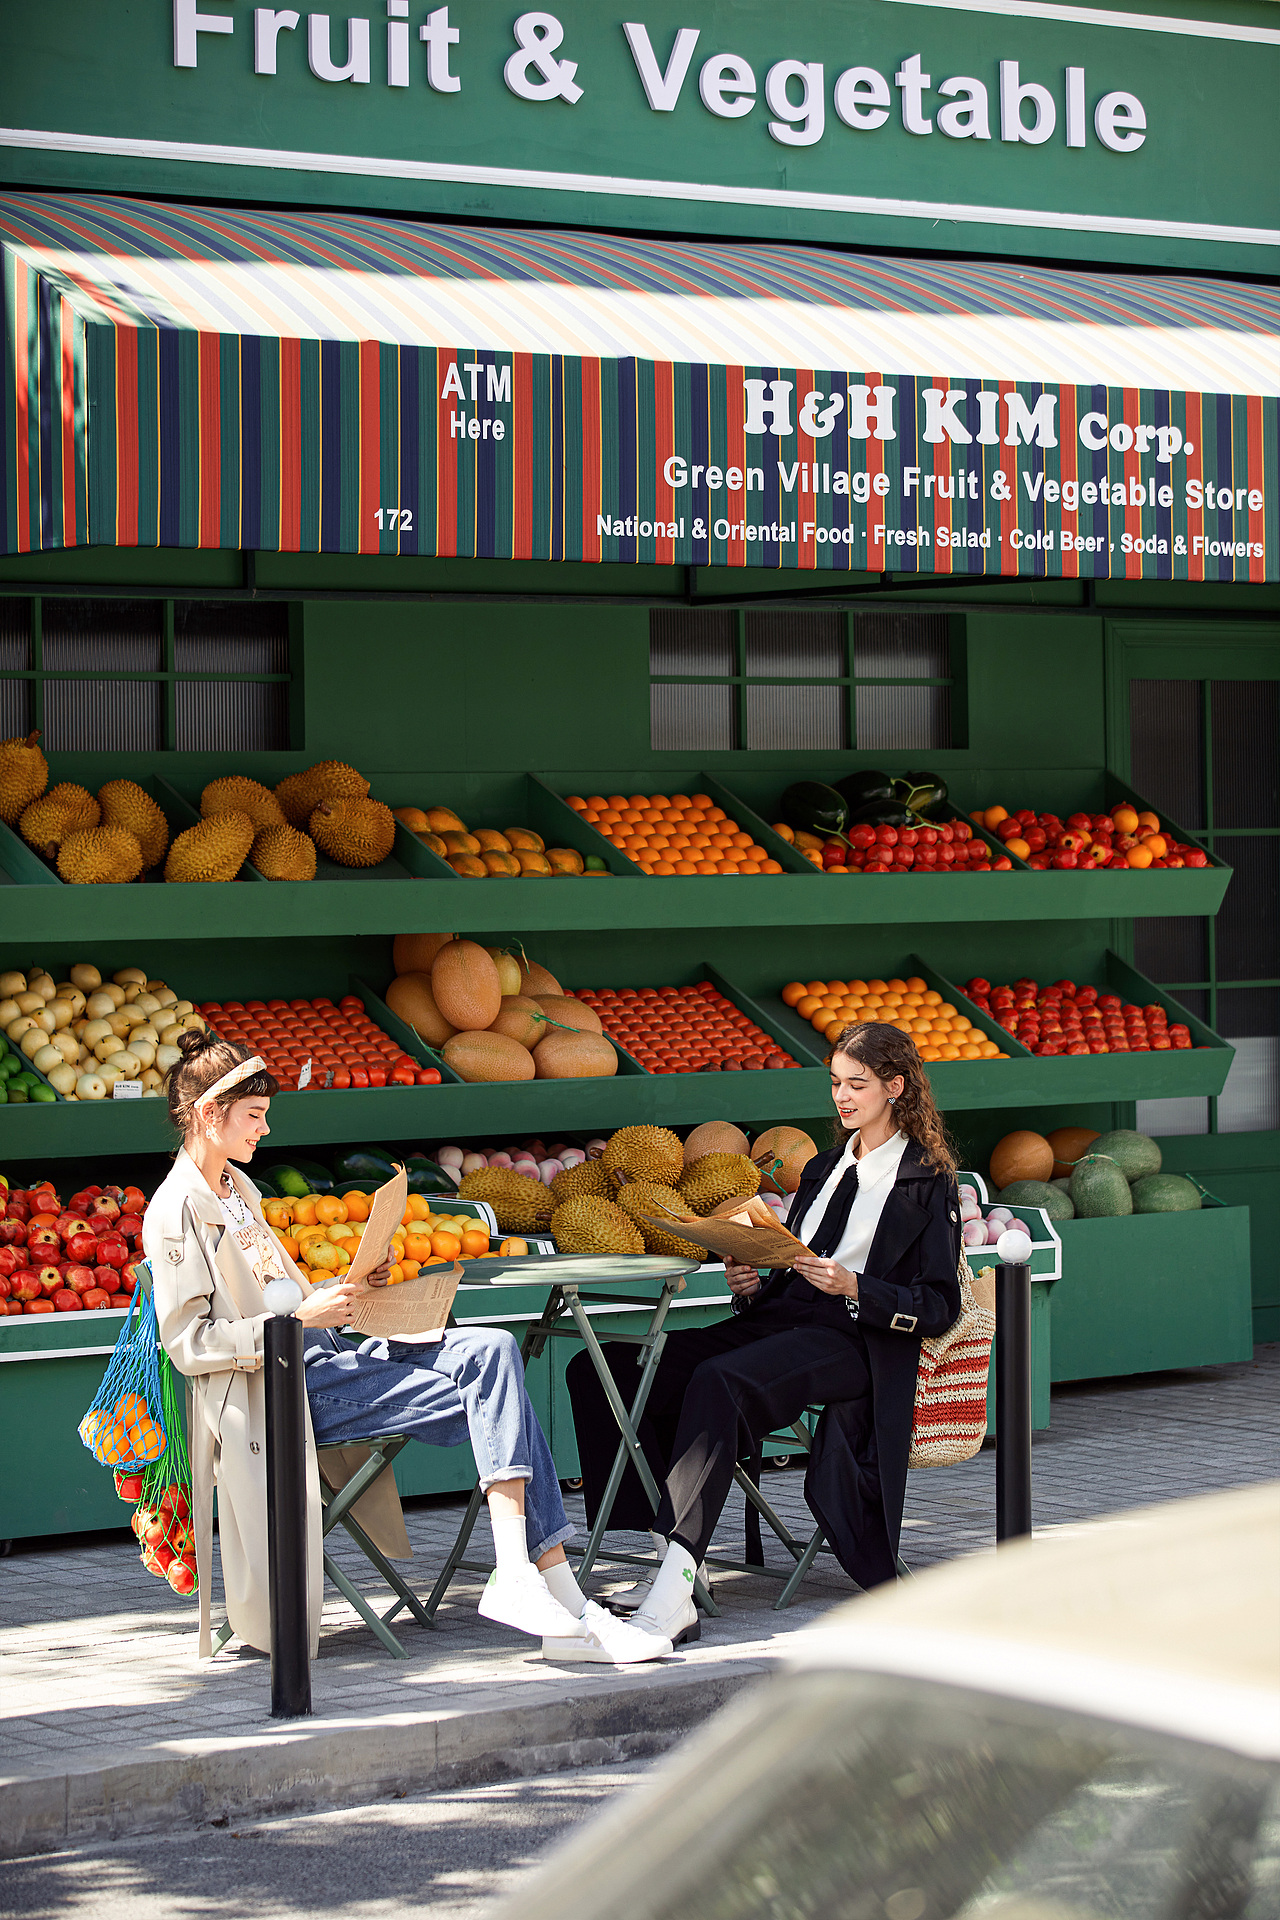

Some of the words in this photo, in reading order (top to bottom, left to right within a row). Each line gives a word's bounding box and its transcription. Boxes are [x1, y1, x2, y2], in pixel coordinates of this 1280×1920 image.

[173, 0, 462, 94] Fruit
[503, 11, 585, 105] &
[622, 22, 1147, 153] Vegetable
[440, 362, 512, 403] ATM
[450, 410, 506, 441] Here
[742, 378, 897, 441] H&H
[921, 388, 1059, 450] KIM
[1078, 411, 1195, 463] Corp.
[663, 455, 765, 492] Green
[776, 461, 891, 504] Village
[903, 466, 979, 501] Fruit
[990, 469, 1013, 502] &
[1021, 470, 1174, 512] Vegetable
[1184, 478, 1264, 512] Store
[373, 507, 413, 531] 172
[596, 513, 685, 539] National
[691, 517, 708, 540] &
[713, 518, 796, 544] Oriental
[802, 521, 855, 545] Food
[873, 523, 931, 547] Fresh
[936, 526, 991, 550] Salad
[1009, 528, 1055, 551] Cold
[1120, 532, 1169, 555] Soda
[1173, 534, 1188, 556] &
[1192, 535, 1265, 559] Flowers
